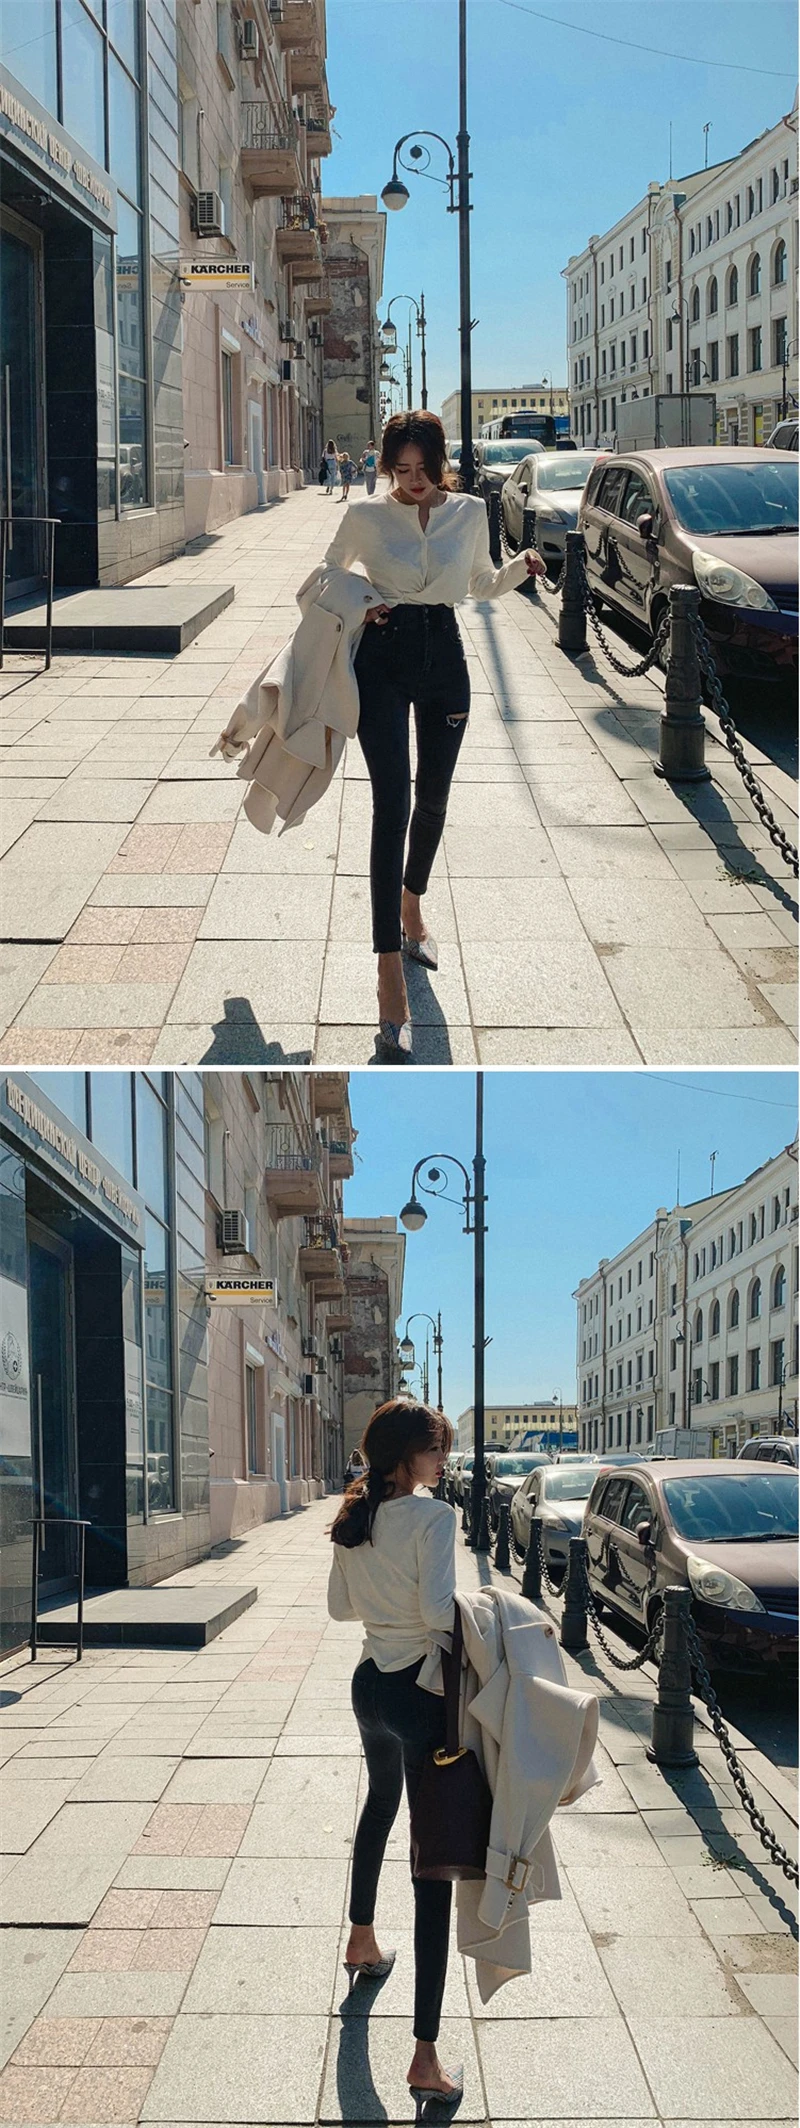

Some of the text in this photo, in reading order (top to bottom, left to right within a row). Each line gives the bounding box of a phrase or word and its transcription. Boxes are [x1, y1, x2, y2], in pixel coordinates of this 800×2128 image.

[190, 264, 250, 274] KÄRCHER
[226, 281, 250, 289] Service
[6, 1077, 76, 1167] МЕДИЦИНСКИЙ
[216, 1280, 273, 1290] KÄRCHER
[249, 1296, 273, 1304] Service
